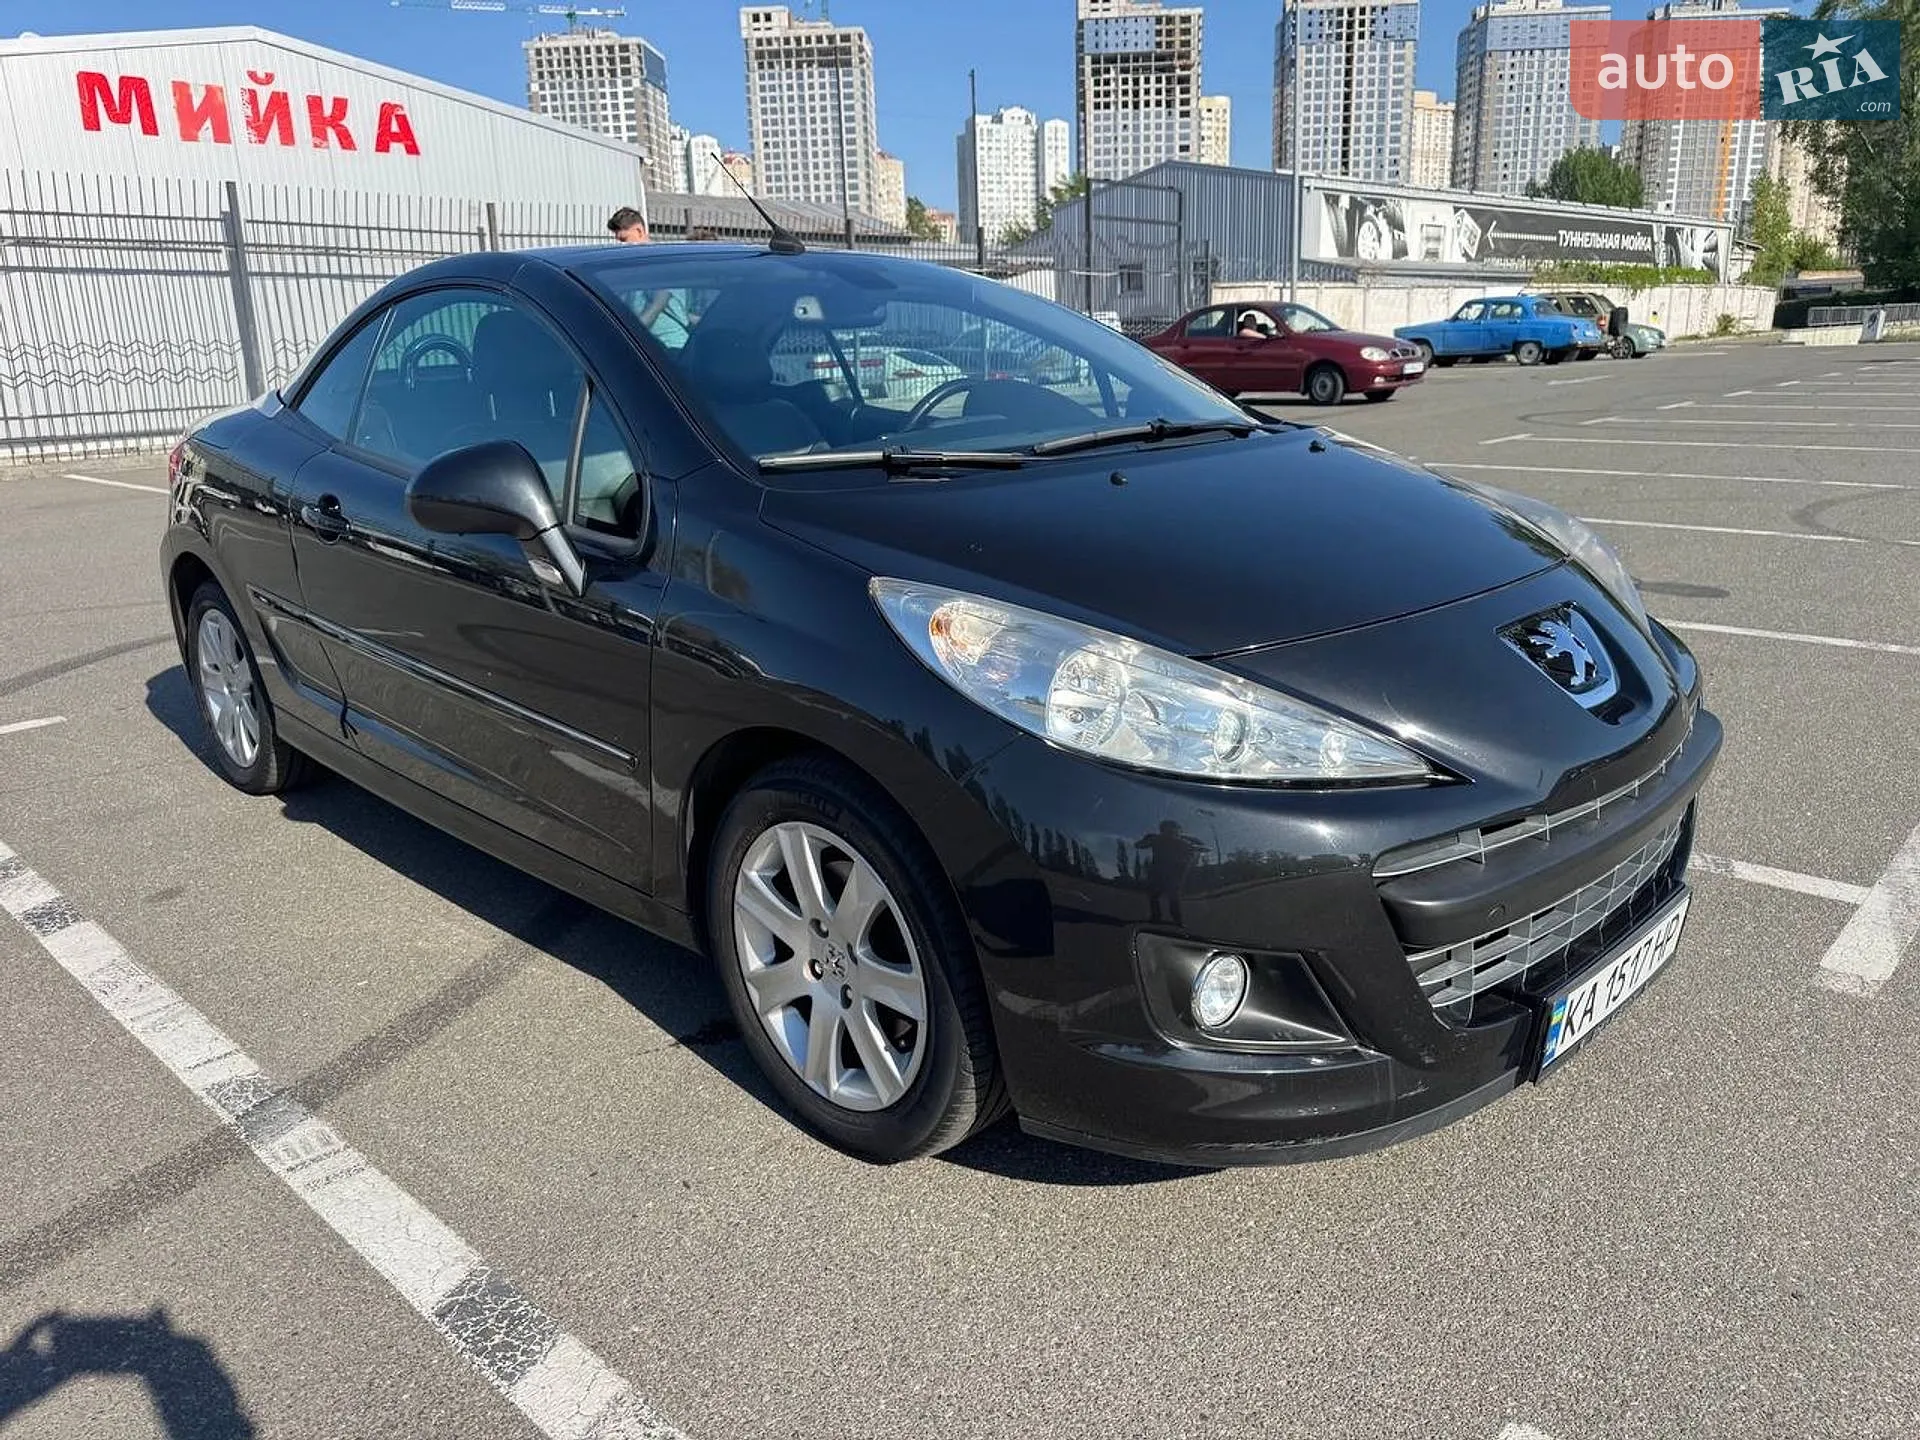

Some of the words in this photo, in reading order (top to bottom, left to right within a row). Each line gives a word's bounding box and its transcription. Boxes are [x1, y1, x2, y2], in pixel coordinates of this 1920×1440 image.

[77, 70, 420, 155] МИЙКА
[1558, 230, 1621, 249] ТУННЕЛЬНАЯ
[1622, 232, 1652, 252] МОЙКА
[1561, 983, 1597, 1045] KA
[1606, 936, 1653, 1007] 1517
